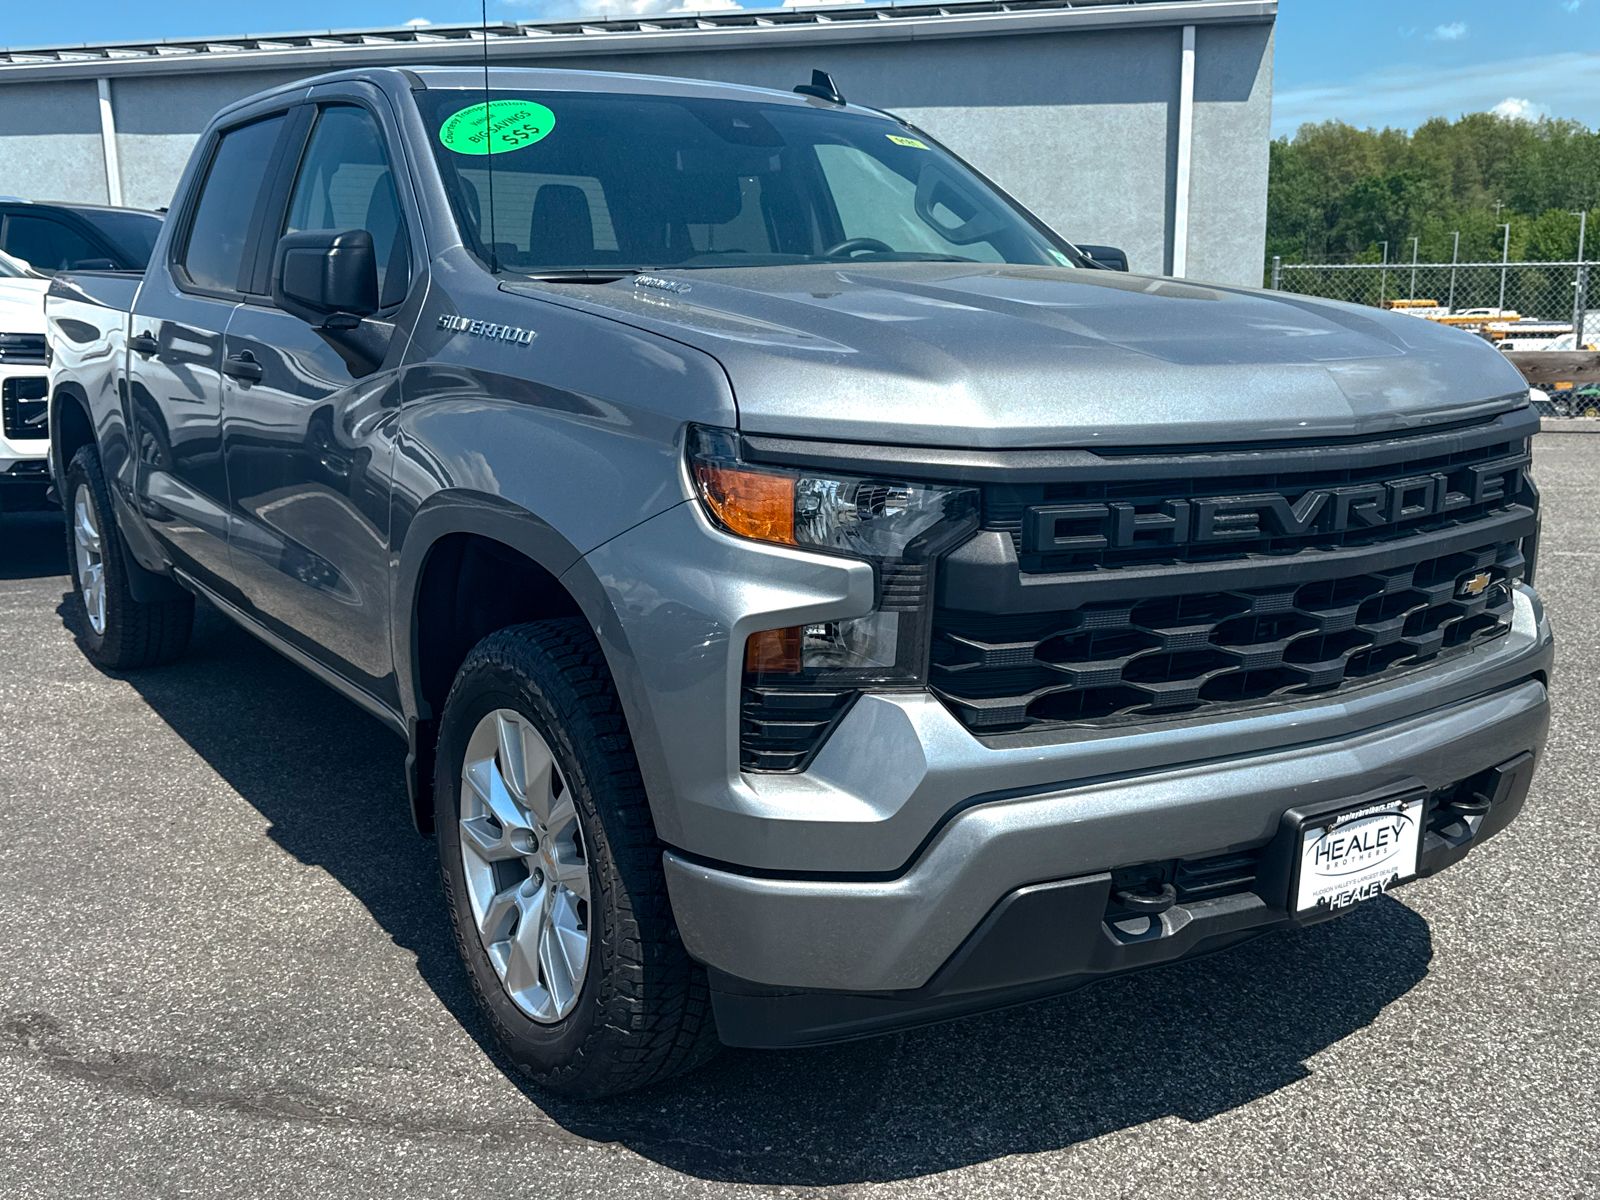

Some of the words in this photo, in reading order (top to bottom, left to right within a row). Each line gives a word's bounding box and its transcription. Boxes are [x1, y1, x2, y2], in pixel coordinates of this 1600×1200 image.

[445, 118, 460, 144] Courtesy
[468, 131, 489, 144] BIG
[488, 111, 531, 133] SAVINGS
[502, 124, 540, 145] $$$
[437, 314, 536, 345] SILVERADO
[1021, 454, 1532, 551] CHEVROLET
[1336, 800, 1402, 823] healeybrothers.com
[1315, 822, 1406, 866] HEALEY
[1326, 848, 1388, 870] BROTHERS
[1313, 886, 1334, 897] HUDSON
[1358, 872, 1379, 884] LARGEST
[1329, 878, 1389, 911] HEALEY
